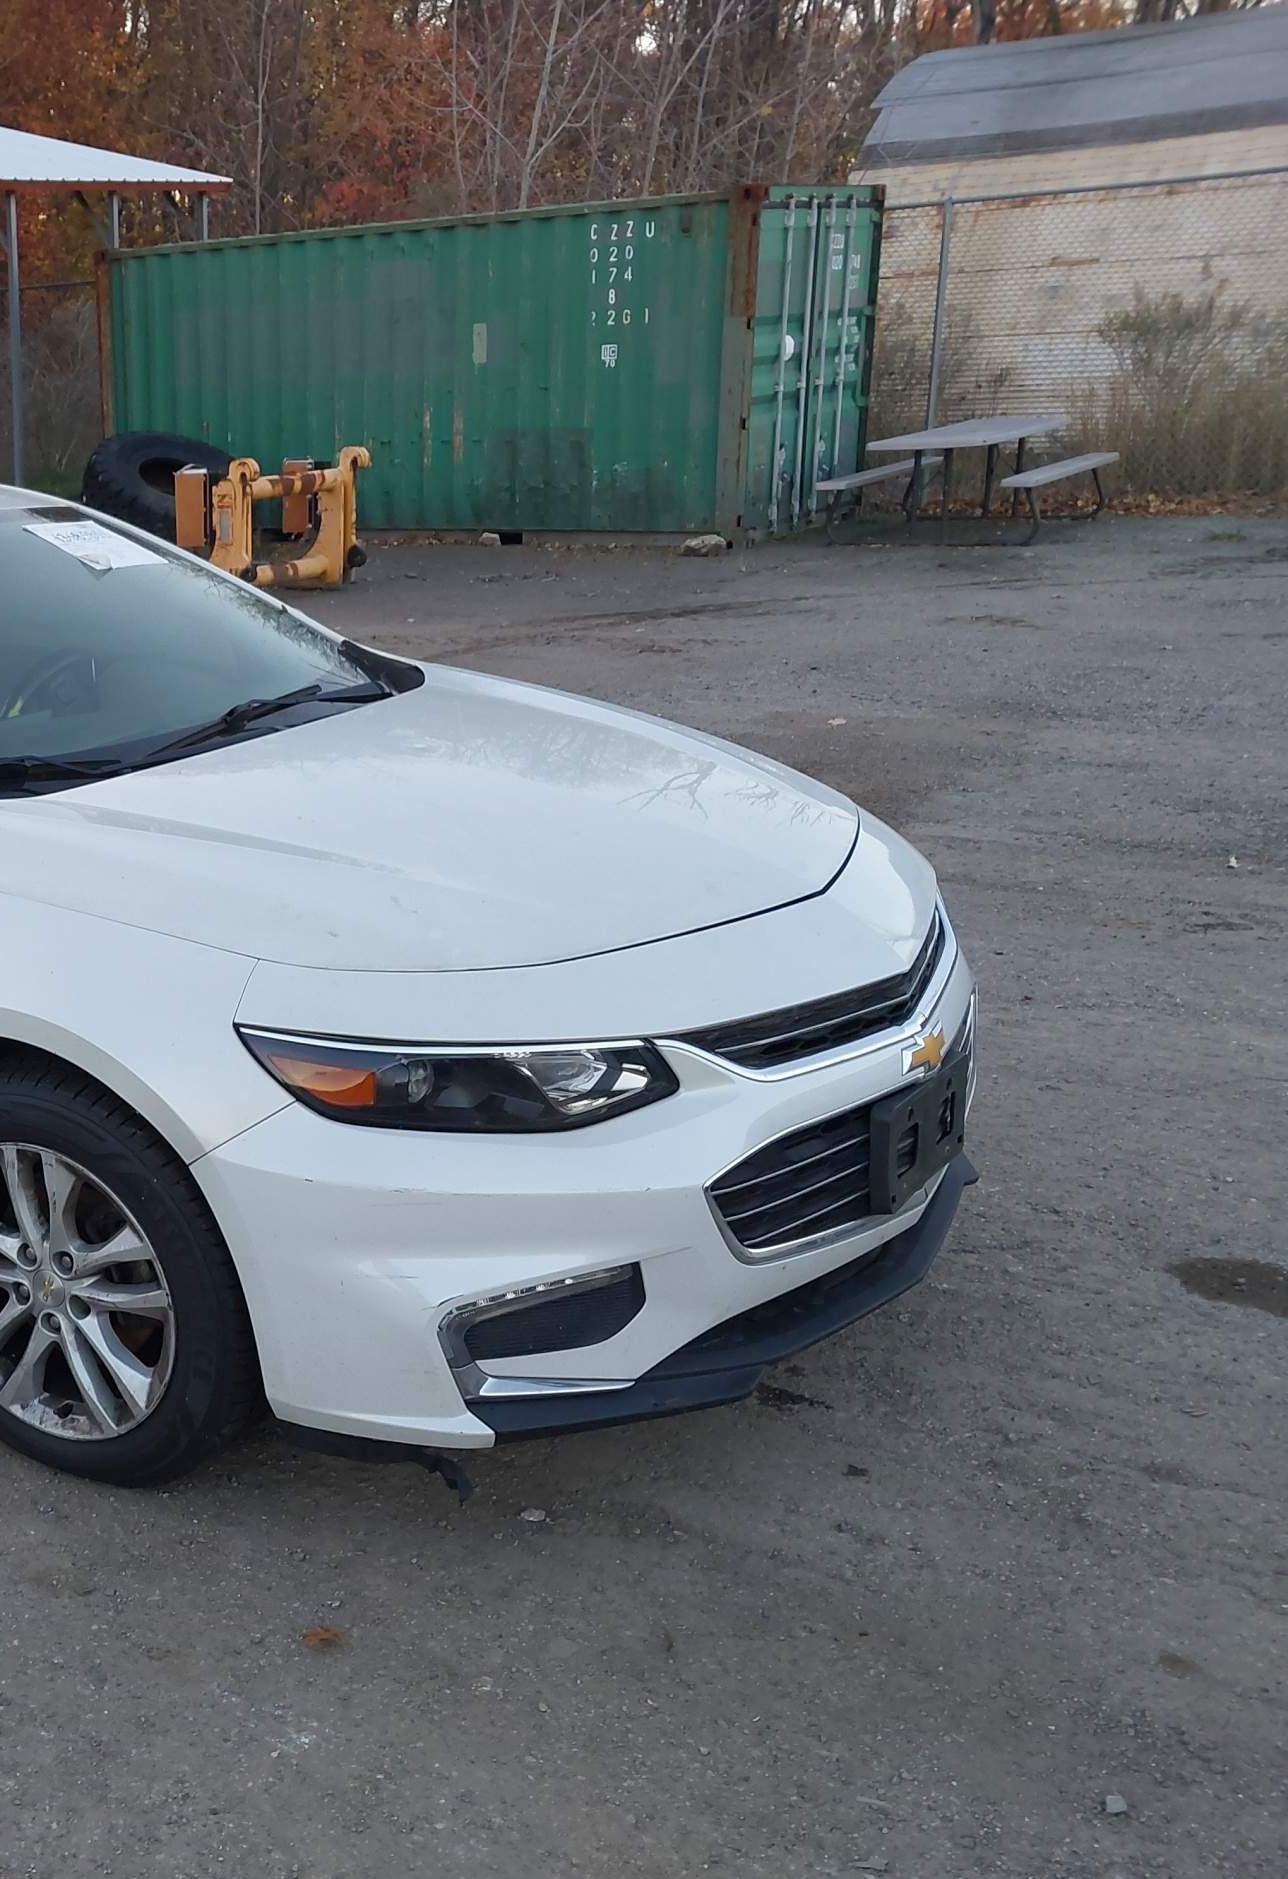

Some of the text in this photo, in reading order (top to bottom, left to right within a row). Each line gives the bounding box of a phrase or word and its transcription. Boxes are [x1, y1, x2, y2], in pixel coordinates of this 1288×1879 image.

[590, 220, 655, 241] CZZU
[589, 244, 635, 263] 020
[608, 288, 616, 305] 8
